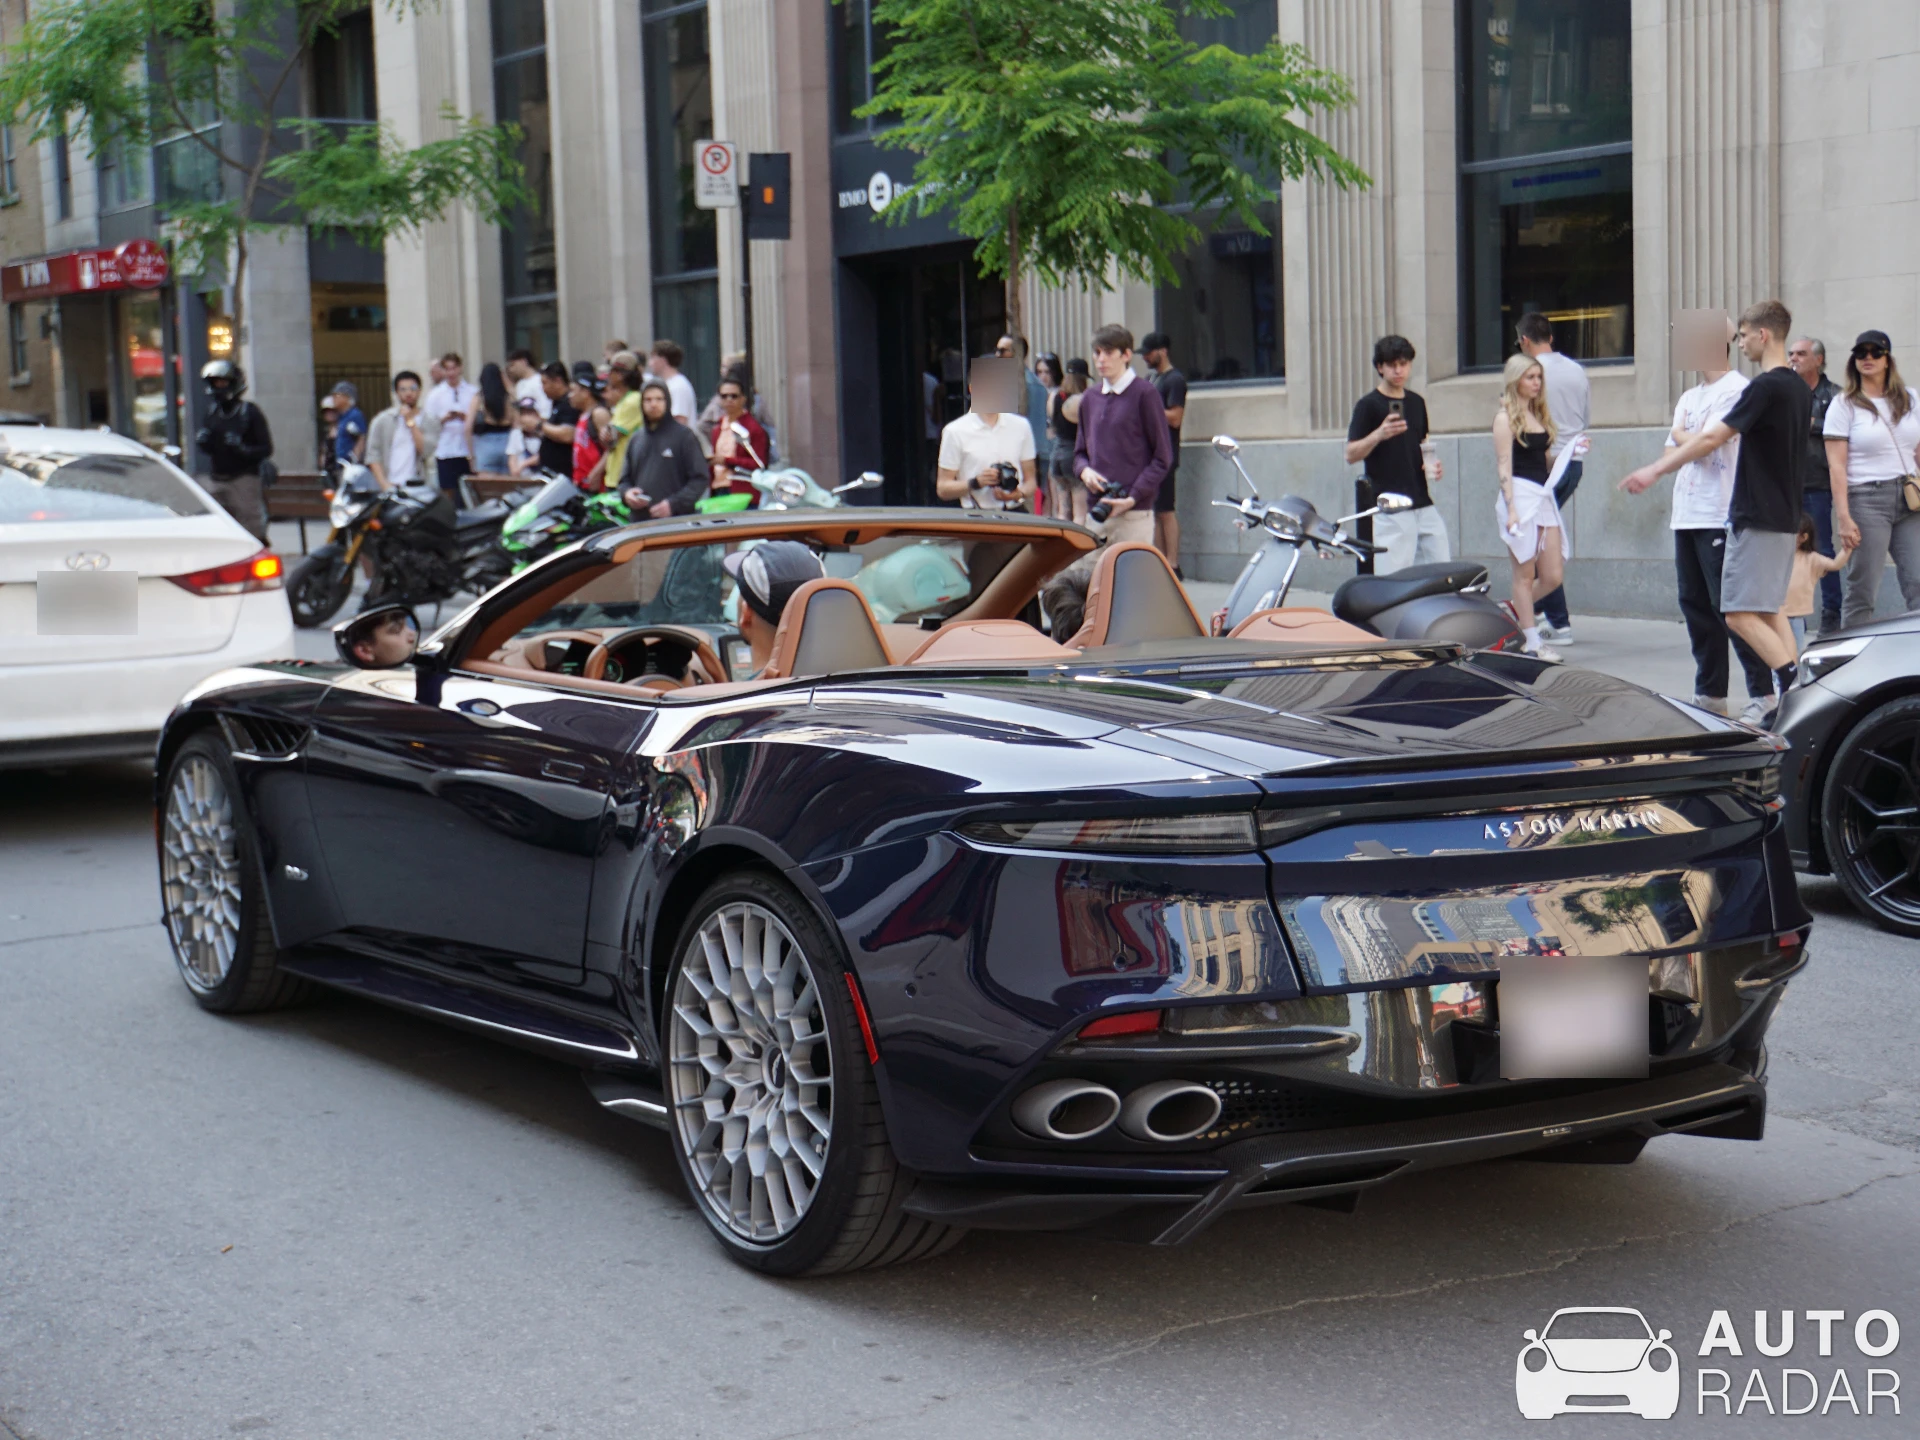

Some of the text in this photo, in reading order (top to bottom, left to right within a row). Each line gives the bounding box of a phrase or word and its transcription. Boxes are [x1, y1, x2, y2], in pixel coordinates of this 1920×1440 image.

[838, 189, 868, 208] BMO
[1484, 810, 1663, 840] ASTON MARTIN
